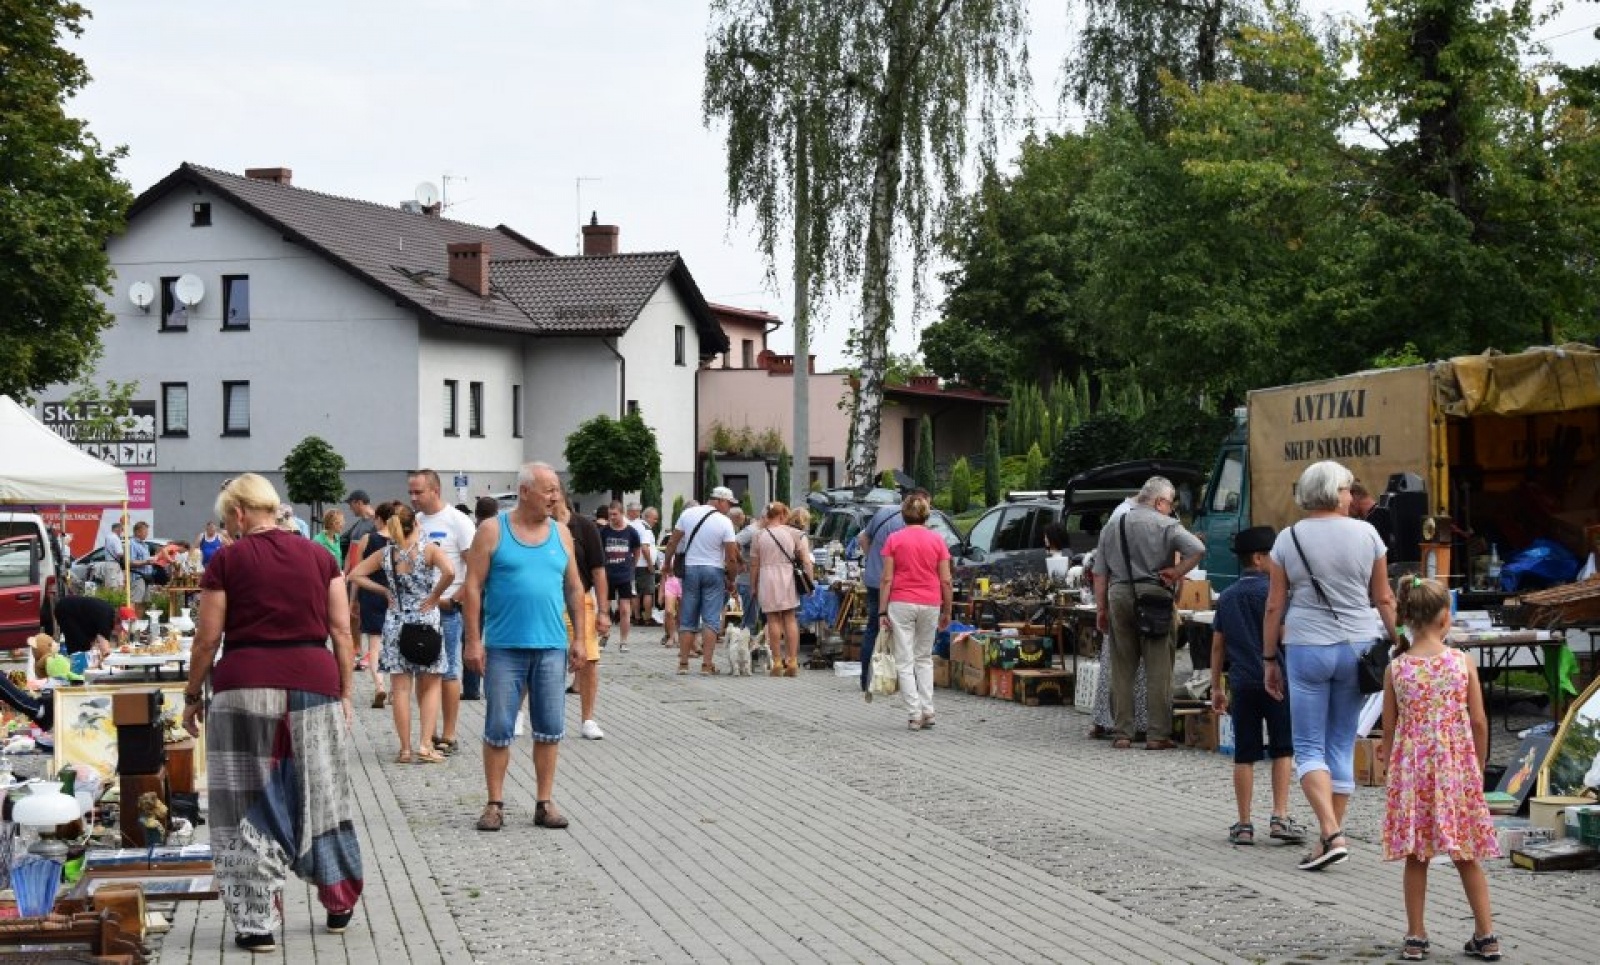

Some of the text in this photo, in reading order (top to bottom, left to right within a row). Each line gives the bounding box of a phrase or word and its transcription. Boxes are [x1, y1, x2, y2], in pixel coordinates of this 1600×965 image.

[45, 405, 113, 421] SKLEP
[1292, 389, 1366, 424] ANTYKI
[1284, 434, 1381, 461] SKUP STAROCI
